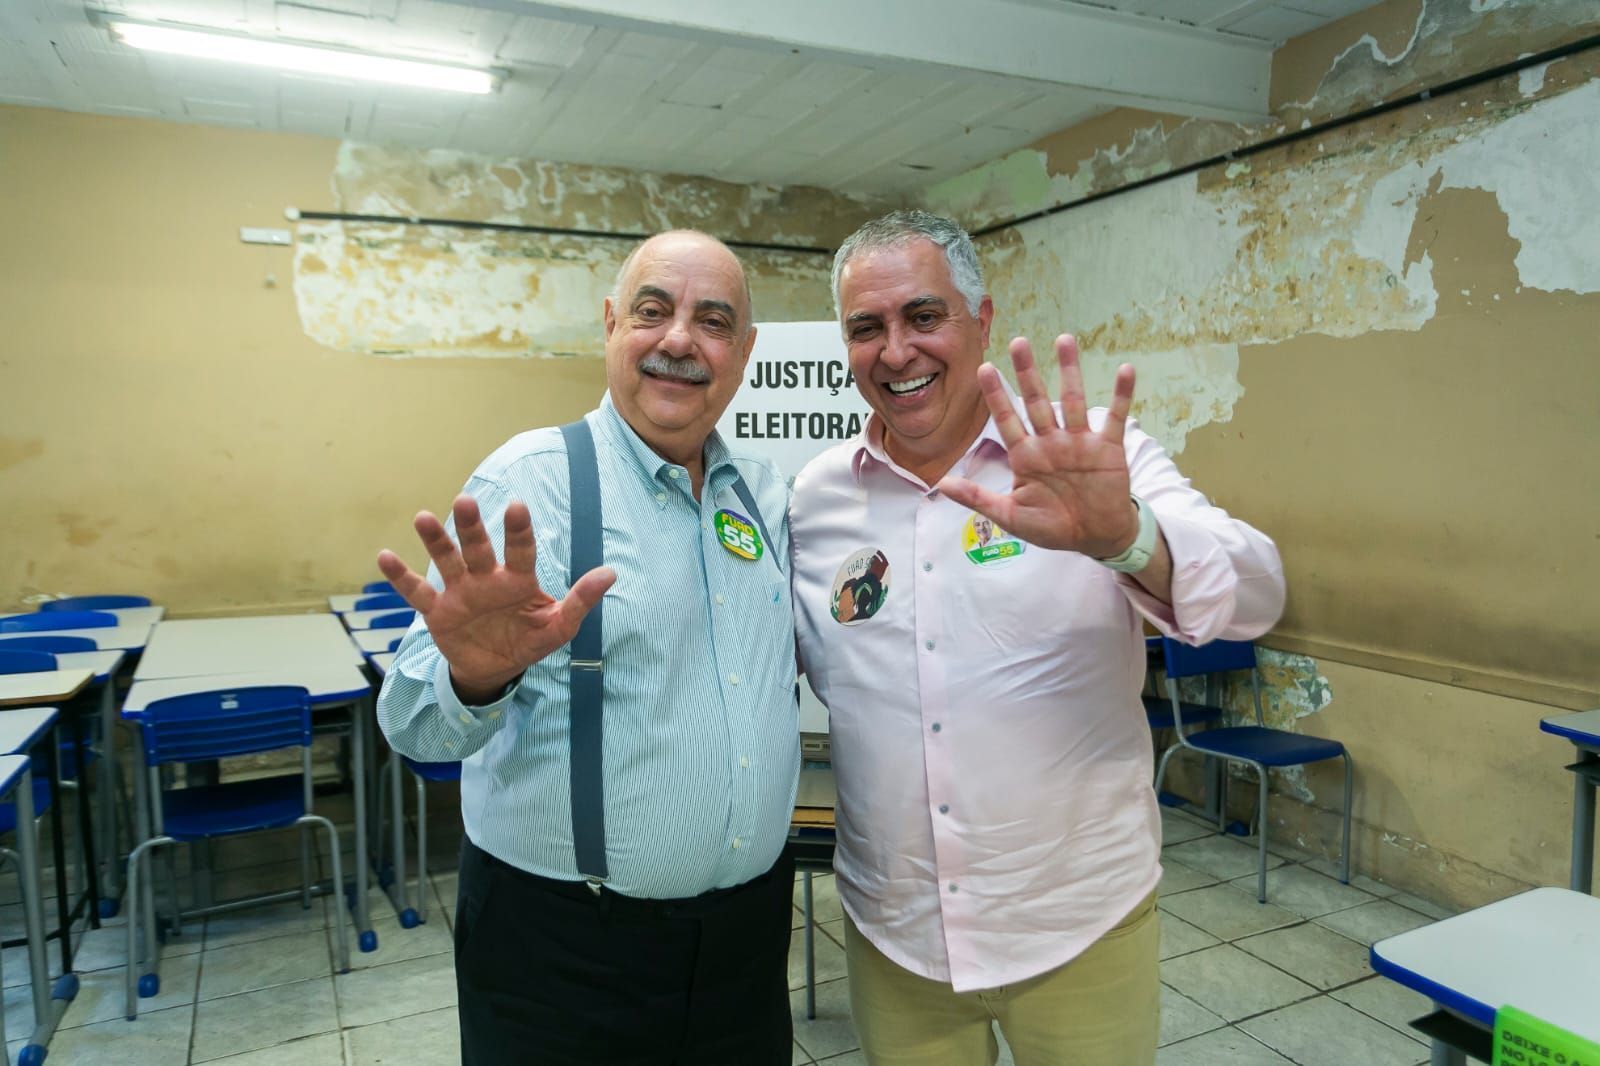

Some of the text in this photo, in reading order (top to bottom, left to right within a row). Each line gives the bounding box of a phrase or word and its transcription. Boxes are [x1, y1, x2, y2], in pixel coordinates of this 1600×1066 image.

[735, 412, 868, 440] ELEITORA
[723, 523, 757, 555] 55
[1000, 545, 1014, 557] 55
[1502, 1030, 1550, 1058] DEIXE
[1502, 1045, 1525, 1062] NO
